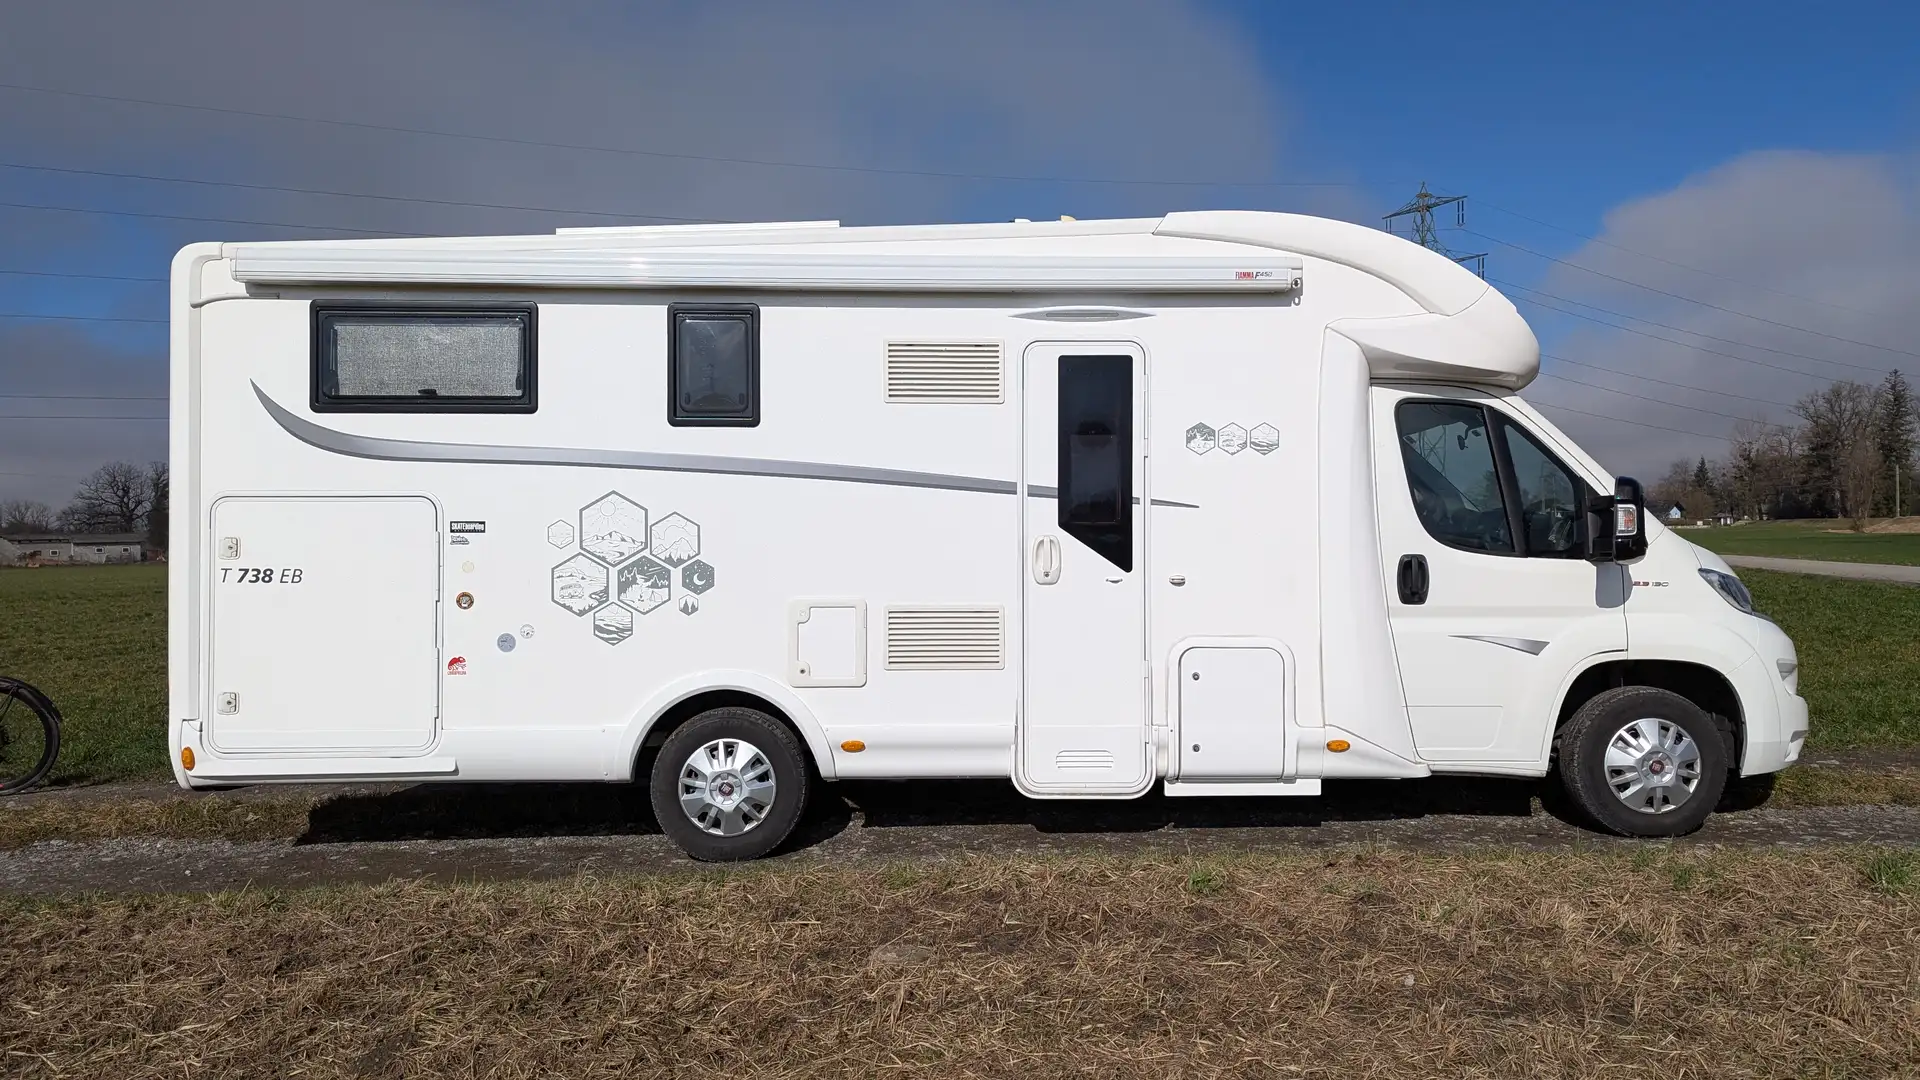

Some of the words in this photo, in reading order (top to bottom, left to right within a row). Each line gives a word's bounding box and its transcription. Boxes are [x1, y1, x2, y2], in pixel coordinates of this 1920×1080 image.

[220, 567, 233, 584] T
[236, 567, 275, 584] 738
[279, 568, 304, 584] EB
